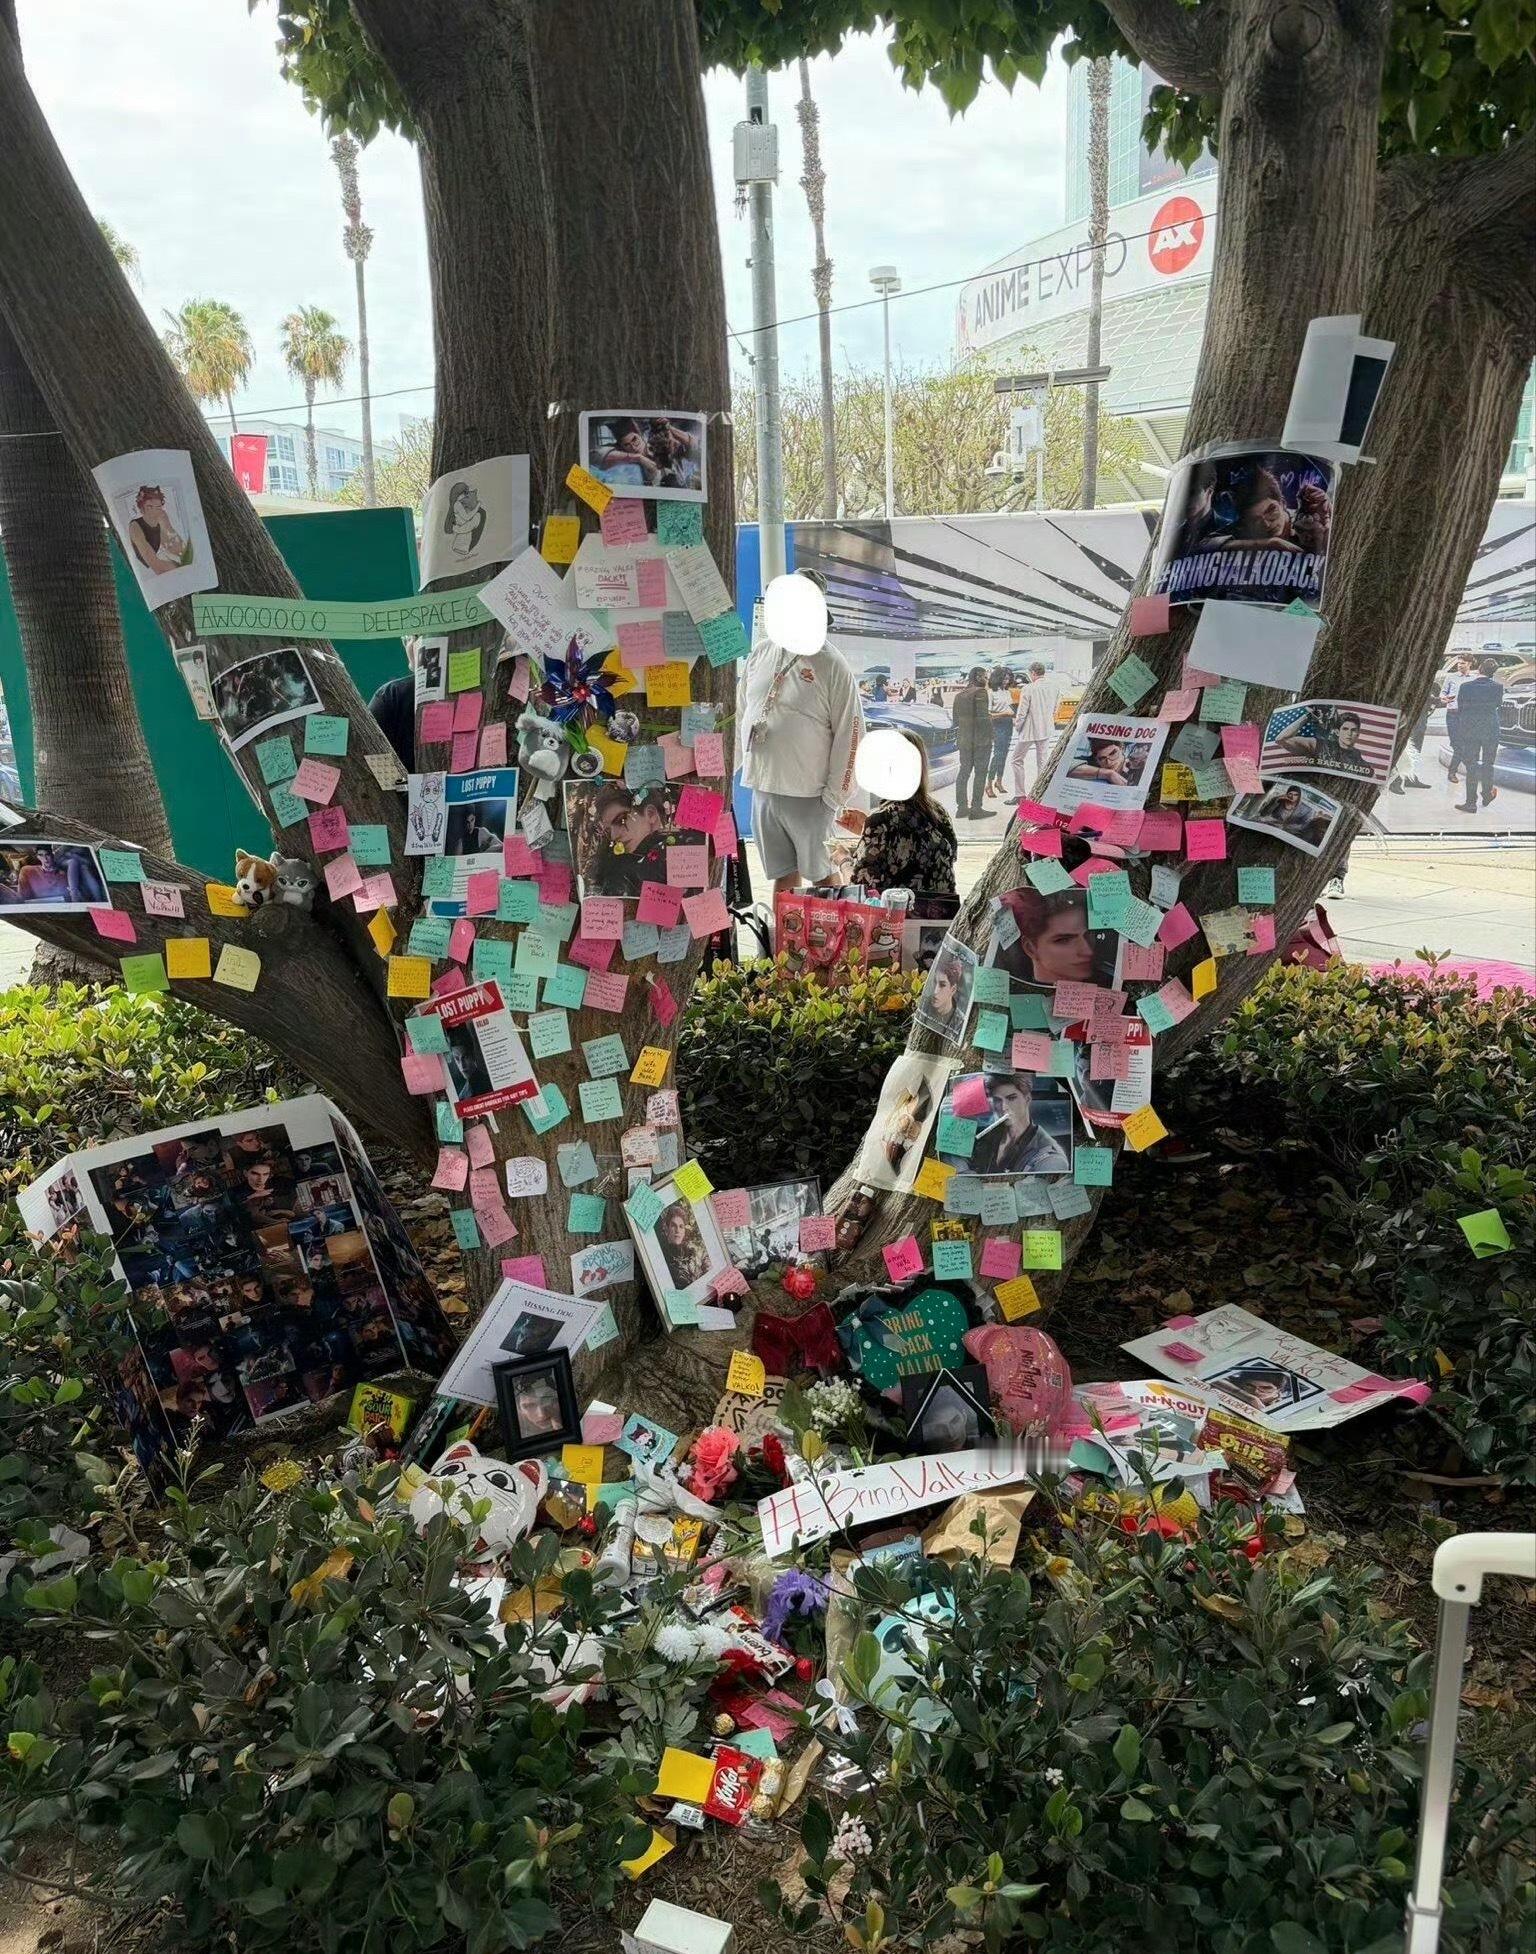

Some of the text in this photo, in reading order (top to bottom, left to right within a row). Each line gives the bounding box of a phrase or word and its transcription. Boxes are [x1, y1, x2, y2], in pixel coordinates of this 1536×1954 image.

[1152, 220, 1198, 255] AX
[975, 232, 1127, 333] ANIME EXPO
[1155, 550, 1326, 594] #BRINGVALKOBACK
[1086, 722, 1157, 739] MISSING DOG
[1317, 758, 1342, 769] BACK
[1342, 762, 1371, 774] VALKO
[461, 775, 497, 793] LOST PUPPY
[435, 991, 486, 1019] LOST PUPPY
[523, 1300, 576, 1318] MISSING DOG
[900, 1333, 934, 1357] BACK
[1270, 1350, 1323, 1378] VALKO
[364, 1400, 392, 1415] SOUR
[739, 1634, 772, 1658] bueno
